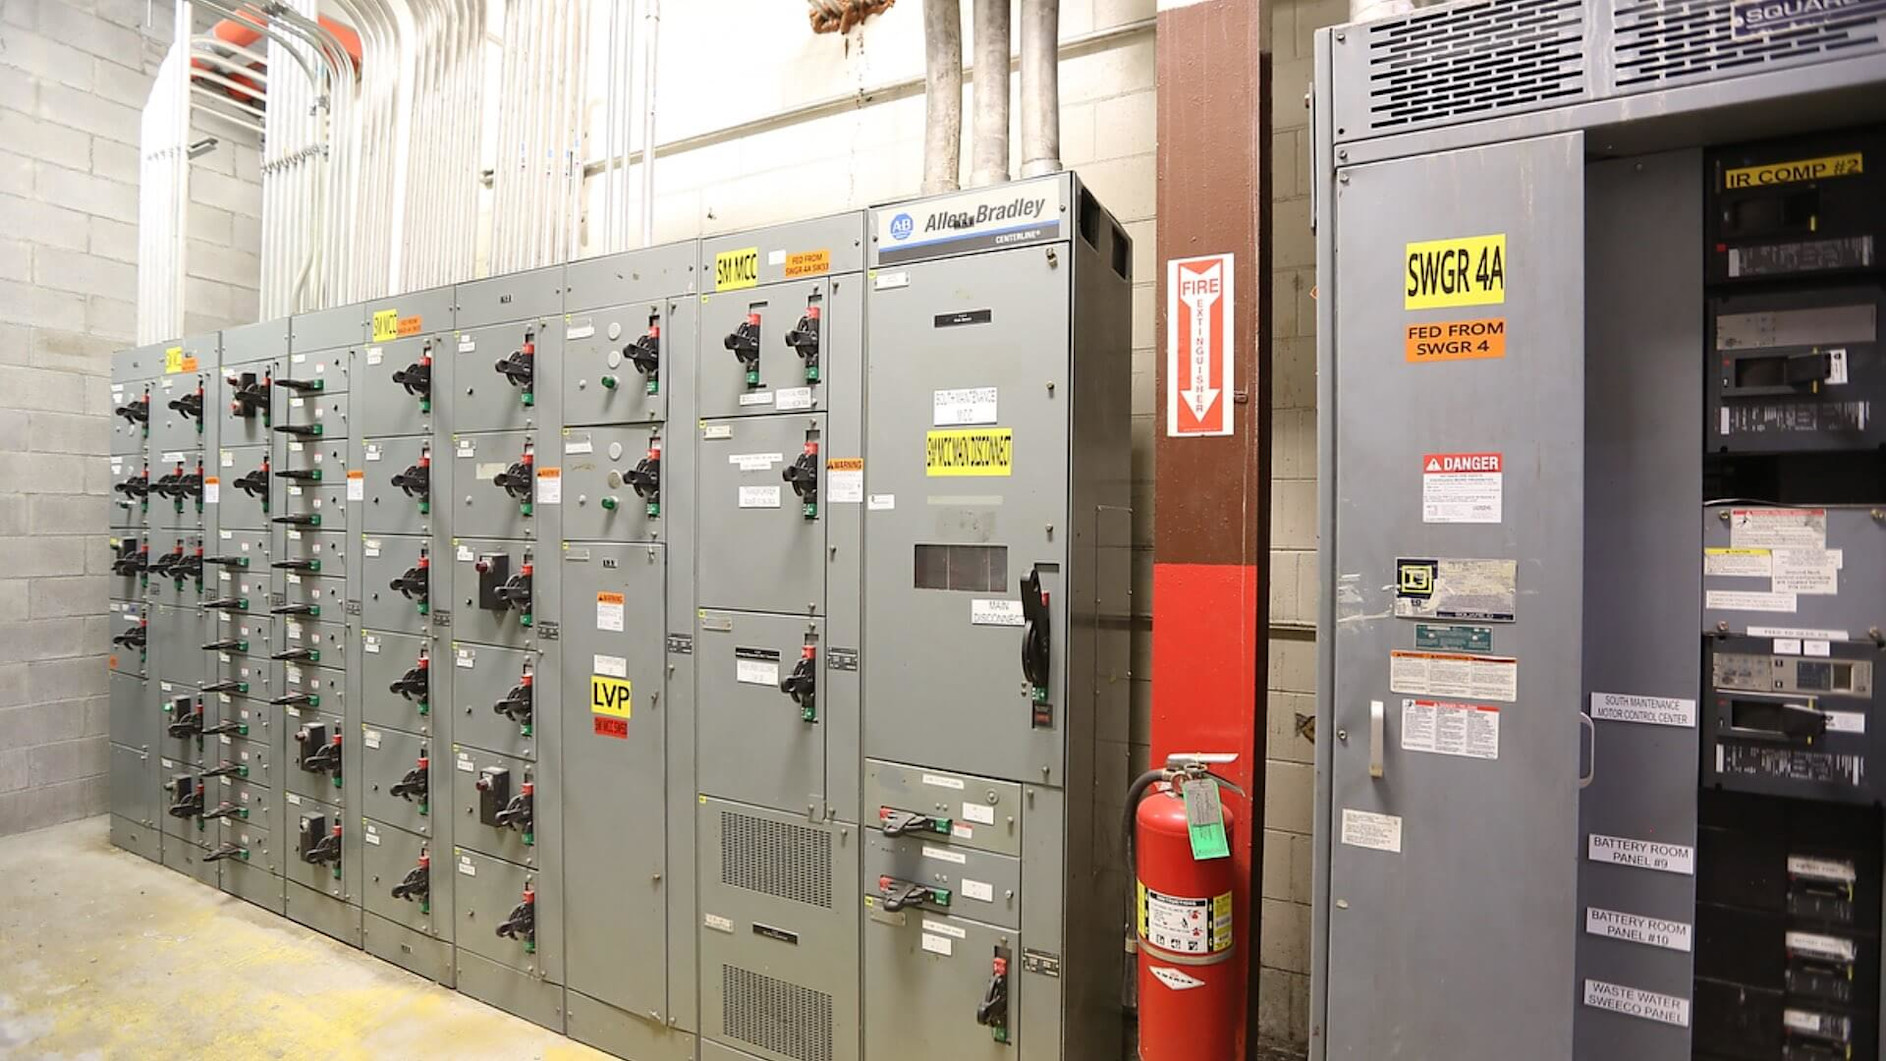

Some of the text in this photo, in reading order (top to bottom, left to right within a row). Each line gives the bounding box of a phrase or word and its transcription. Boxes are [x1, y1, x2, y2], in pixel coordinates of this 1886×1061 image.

[1730, 158, 1859, 187] IR COMP #2
[893, 218, 912, 231] AB
[805, 253, 823, 263] FROM
[718, 253, 757, 285] SM MCC
[1407, 245, 1504, 297] SWGR 4A
[1183, 278, 1219, 296] FIRE
[1408, 321, 1504, 340] FED FROM
[1196, 299, 1204, 412] EXTINGUISHER
[1417, 340, 1490, 356] SWGR 4
[970, 435, 1012, 467] DISCONNECT
[833, 460, 862, 470] WARNING
[1444, 456, 1499, 471] DANGER
[989, 600, 1010, 611] MAIN
[593, 682, 630, 709] LVP
[1605, 695, 1680, 711] SOUTH MAINTENANCE
[1598, 708, 1688, 724] MOTOR CONTROL CENTER
[1594, 836, 1689, 858] BATTERY ROOM
[1613, 852, 1668, 869] PANEL #9
[1592, 910, 1687, 936] BATTERY ROOM
[1607, 925, 1669, 945] PANEL #10
[1593, 982, 1680, 1010] WASTE WATER
[1588, 994, 1682, 1022] SWEECO PANEL
